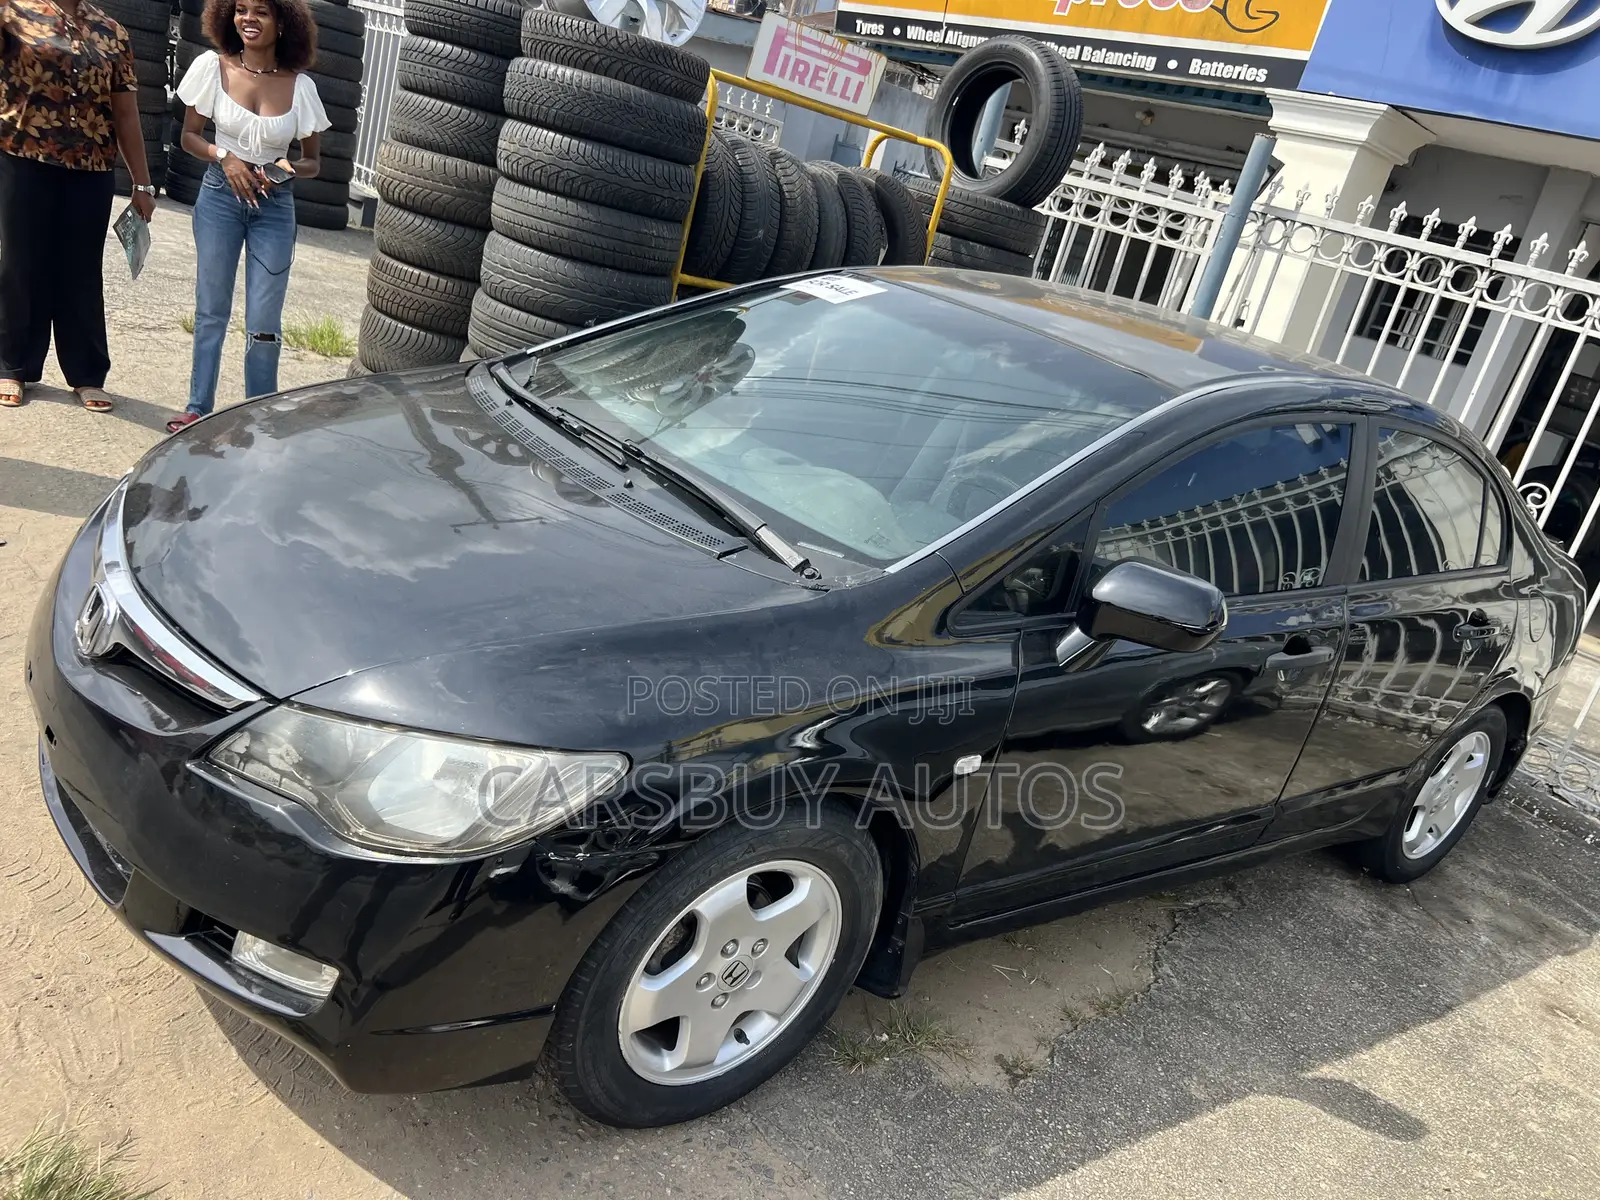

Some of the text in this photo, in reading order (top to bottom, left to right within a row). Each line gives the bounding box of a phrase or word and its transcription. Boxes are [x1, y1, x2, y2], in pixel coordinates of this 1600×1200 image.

[763, 25, 872, 104] PIRELLI
[855, 19, 885, 36] Tyres
[907, 25, 944, 43] Wheel
[1081, 45, 1157, 71] Balancing
[1188, 58, 1268, 83] Batteries
[825, 284, 859, 296] SALE
